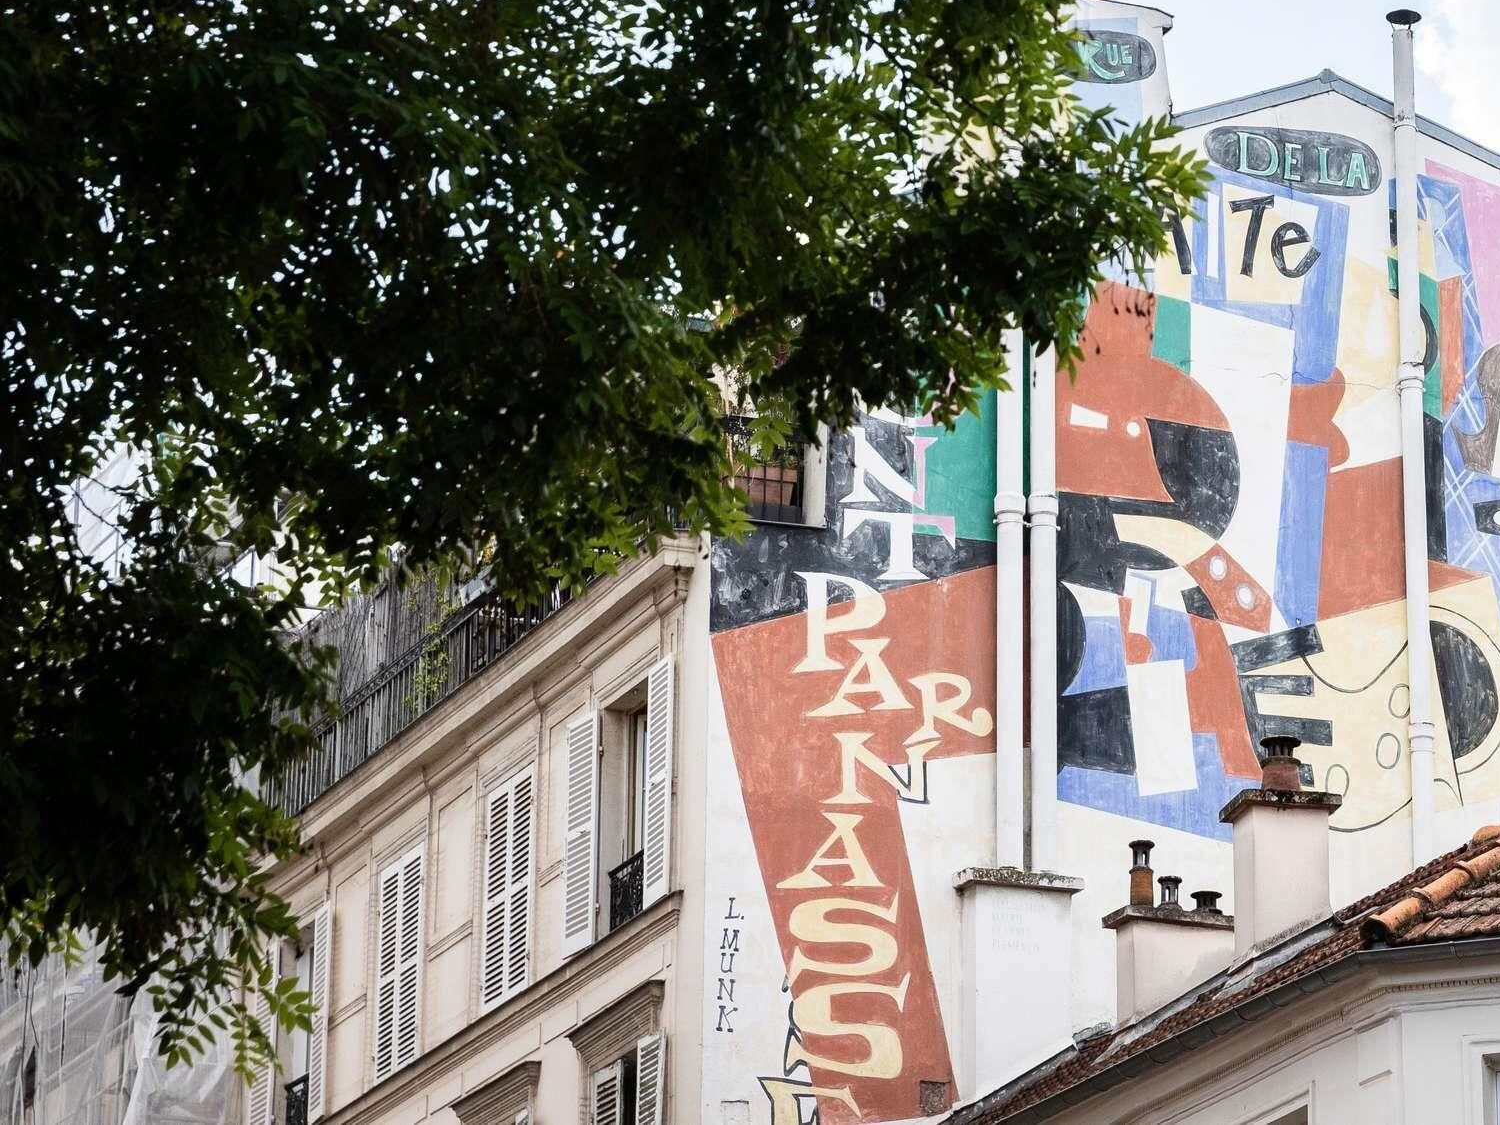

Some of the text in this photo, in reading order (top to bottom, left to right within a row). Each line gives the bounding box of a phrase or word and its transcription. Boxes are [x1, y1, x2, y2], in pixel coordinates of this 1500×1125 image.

[1077, 39, 1134, 80] RUE
[1235, 131, 1370, 190] DE LA
[715, 928, 740, 1033] MUNK
